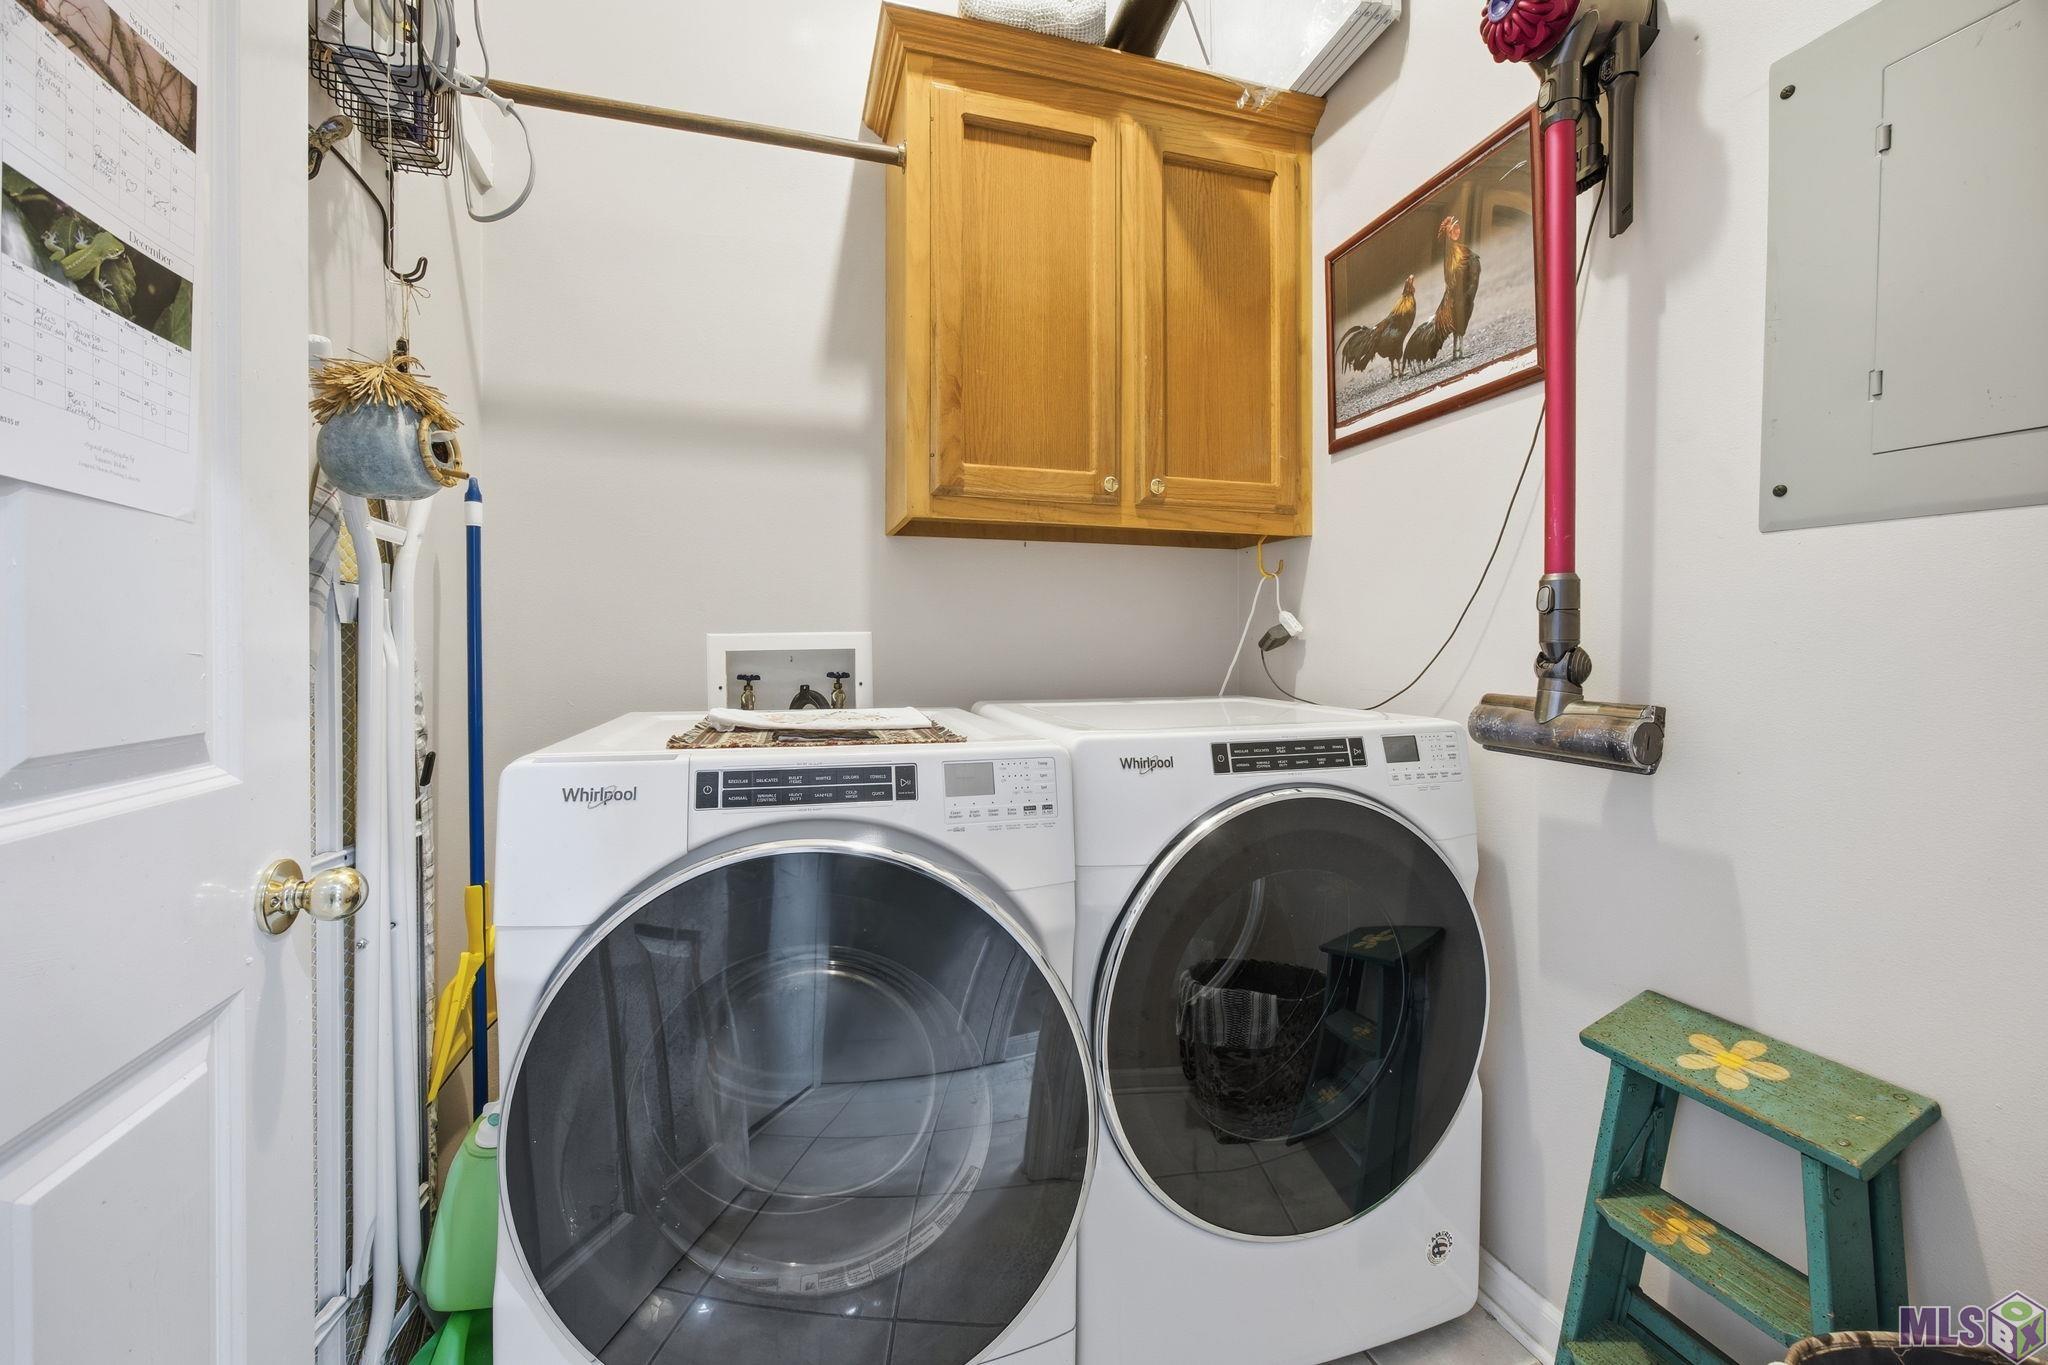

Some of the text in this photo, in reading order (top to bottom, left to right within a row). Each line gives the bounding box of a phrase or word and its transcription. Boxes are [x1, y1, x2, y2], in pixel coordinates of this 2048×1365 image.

[129, 12, 178, 62] September
[129, 231, 175, 266] December
[12, 261, 25, 273] Sun.
[43, 278, 58, 290] Mon.
[73, 293, 86, 305] Tues.
[1119, 755, 1174, 774] Whirlpool
[562, 786, 637, 809] Whirlpool
